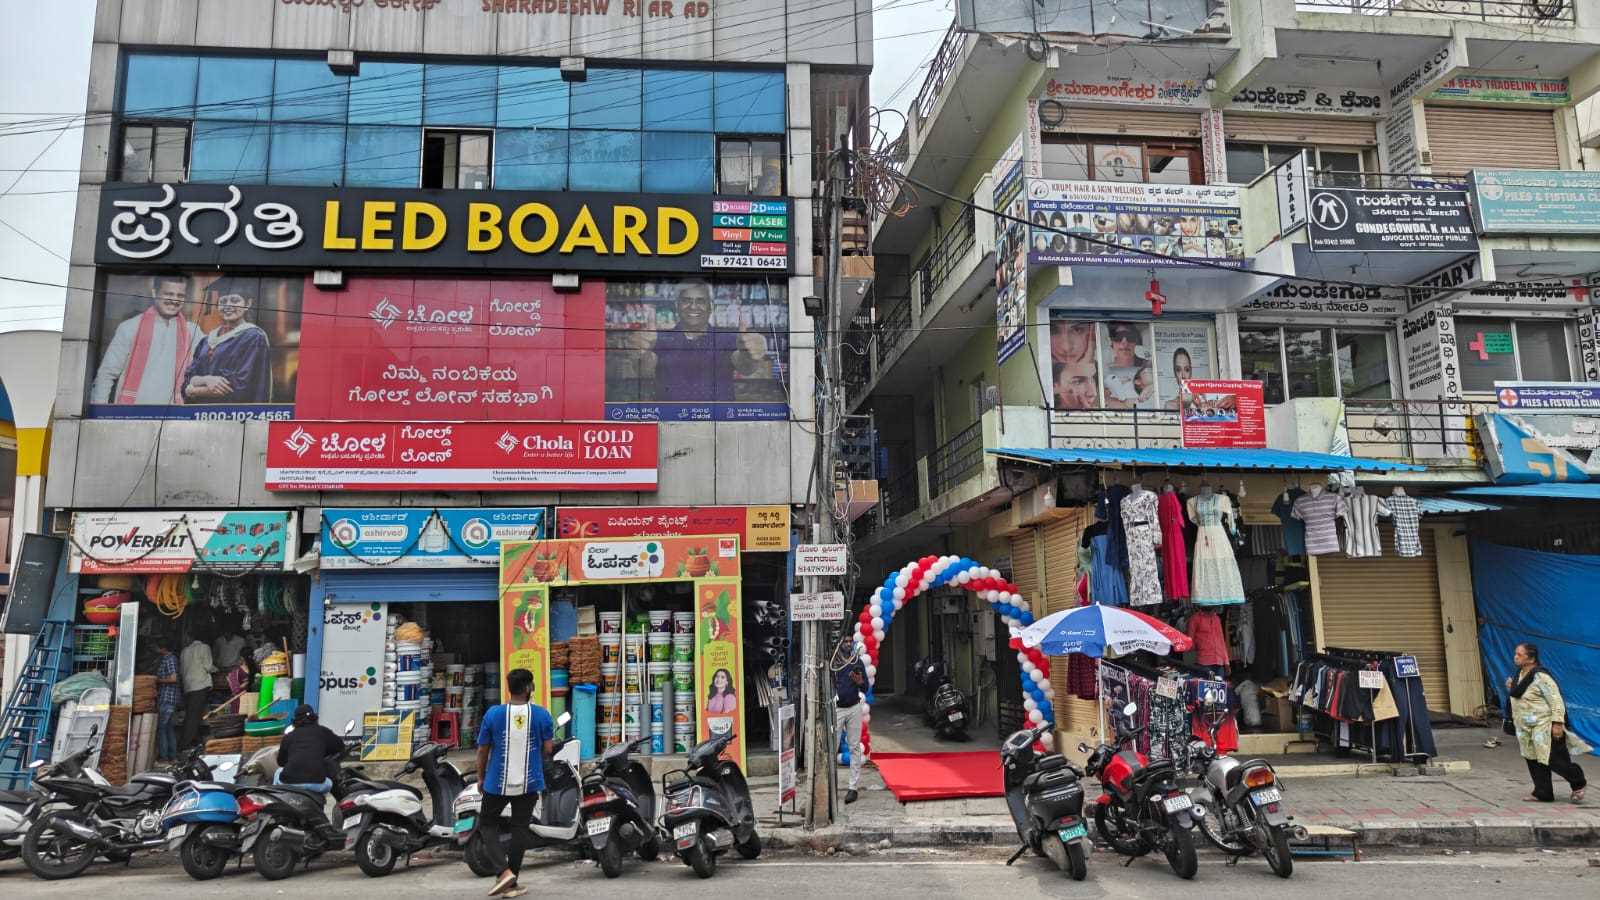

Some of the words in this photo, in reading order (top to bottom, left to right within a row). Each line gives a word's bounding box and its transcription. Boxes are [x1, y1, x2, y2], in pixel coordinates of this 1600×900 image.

[1390, 70, 1420, 99] MAHESH
[1424, 61, 1433, 74] &
[1434, 48, 1449, 65] CO
[1458, 79, 1482, 89] SEAS
[1486, 80, 1537, 92] TRADELINK
[1074, 184, 1089, 192] HAIR
[1097, 185, 1112, 193] SKIN
[1113, 186, 1145, 194] WELLNESS
[1286, 161, 1296, 223] NOTARY
[713, 202, 729, 212] 3D
[752, 203, 767, 213] 2D
[108, 184, 303, 259] ಪ್ರಗತಿ
[720, 216, 744, 225] CNC
[753, 217, 783, 226] LASER
[322, 200, 447, 250] LED
[467, 202, 699, 255] BOARD
[721, 230, 742, 240] Vinyl
[753, 231, 766, 239] UV
[702, 257, 713, 265] Ph
[723, 257, 752, 265] 97421
[757, 258, 786, 266] 06421
[1411, 259, 1475, 305] NOTARY
[382, 364, 428, 383] ನಿಮ್ಮ
[432, 365, 518, 382] ನಂಬಿಕೆಯ
[415, 386, 477, 404] ಲೋನ್
[1521, 398, 1540, 407] PILES
[1550, 398, 1580, 407] FISTULA
[194, 411, 291, 421] 1800-102-4565
[321, 432, 387, 452] ಚೋಳ
[523, 435, 574, 450] Chola
[583, 429, 634, 444] GOLD
[401, 448, 452, 462] ಲೋನ್
[564, 451, 574, 459] life
[584, 445, 633, 459] LOAN
[364, 529, 403, 537] ashirvad
[588, 553, 639, 569] ಓಪಸ್
